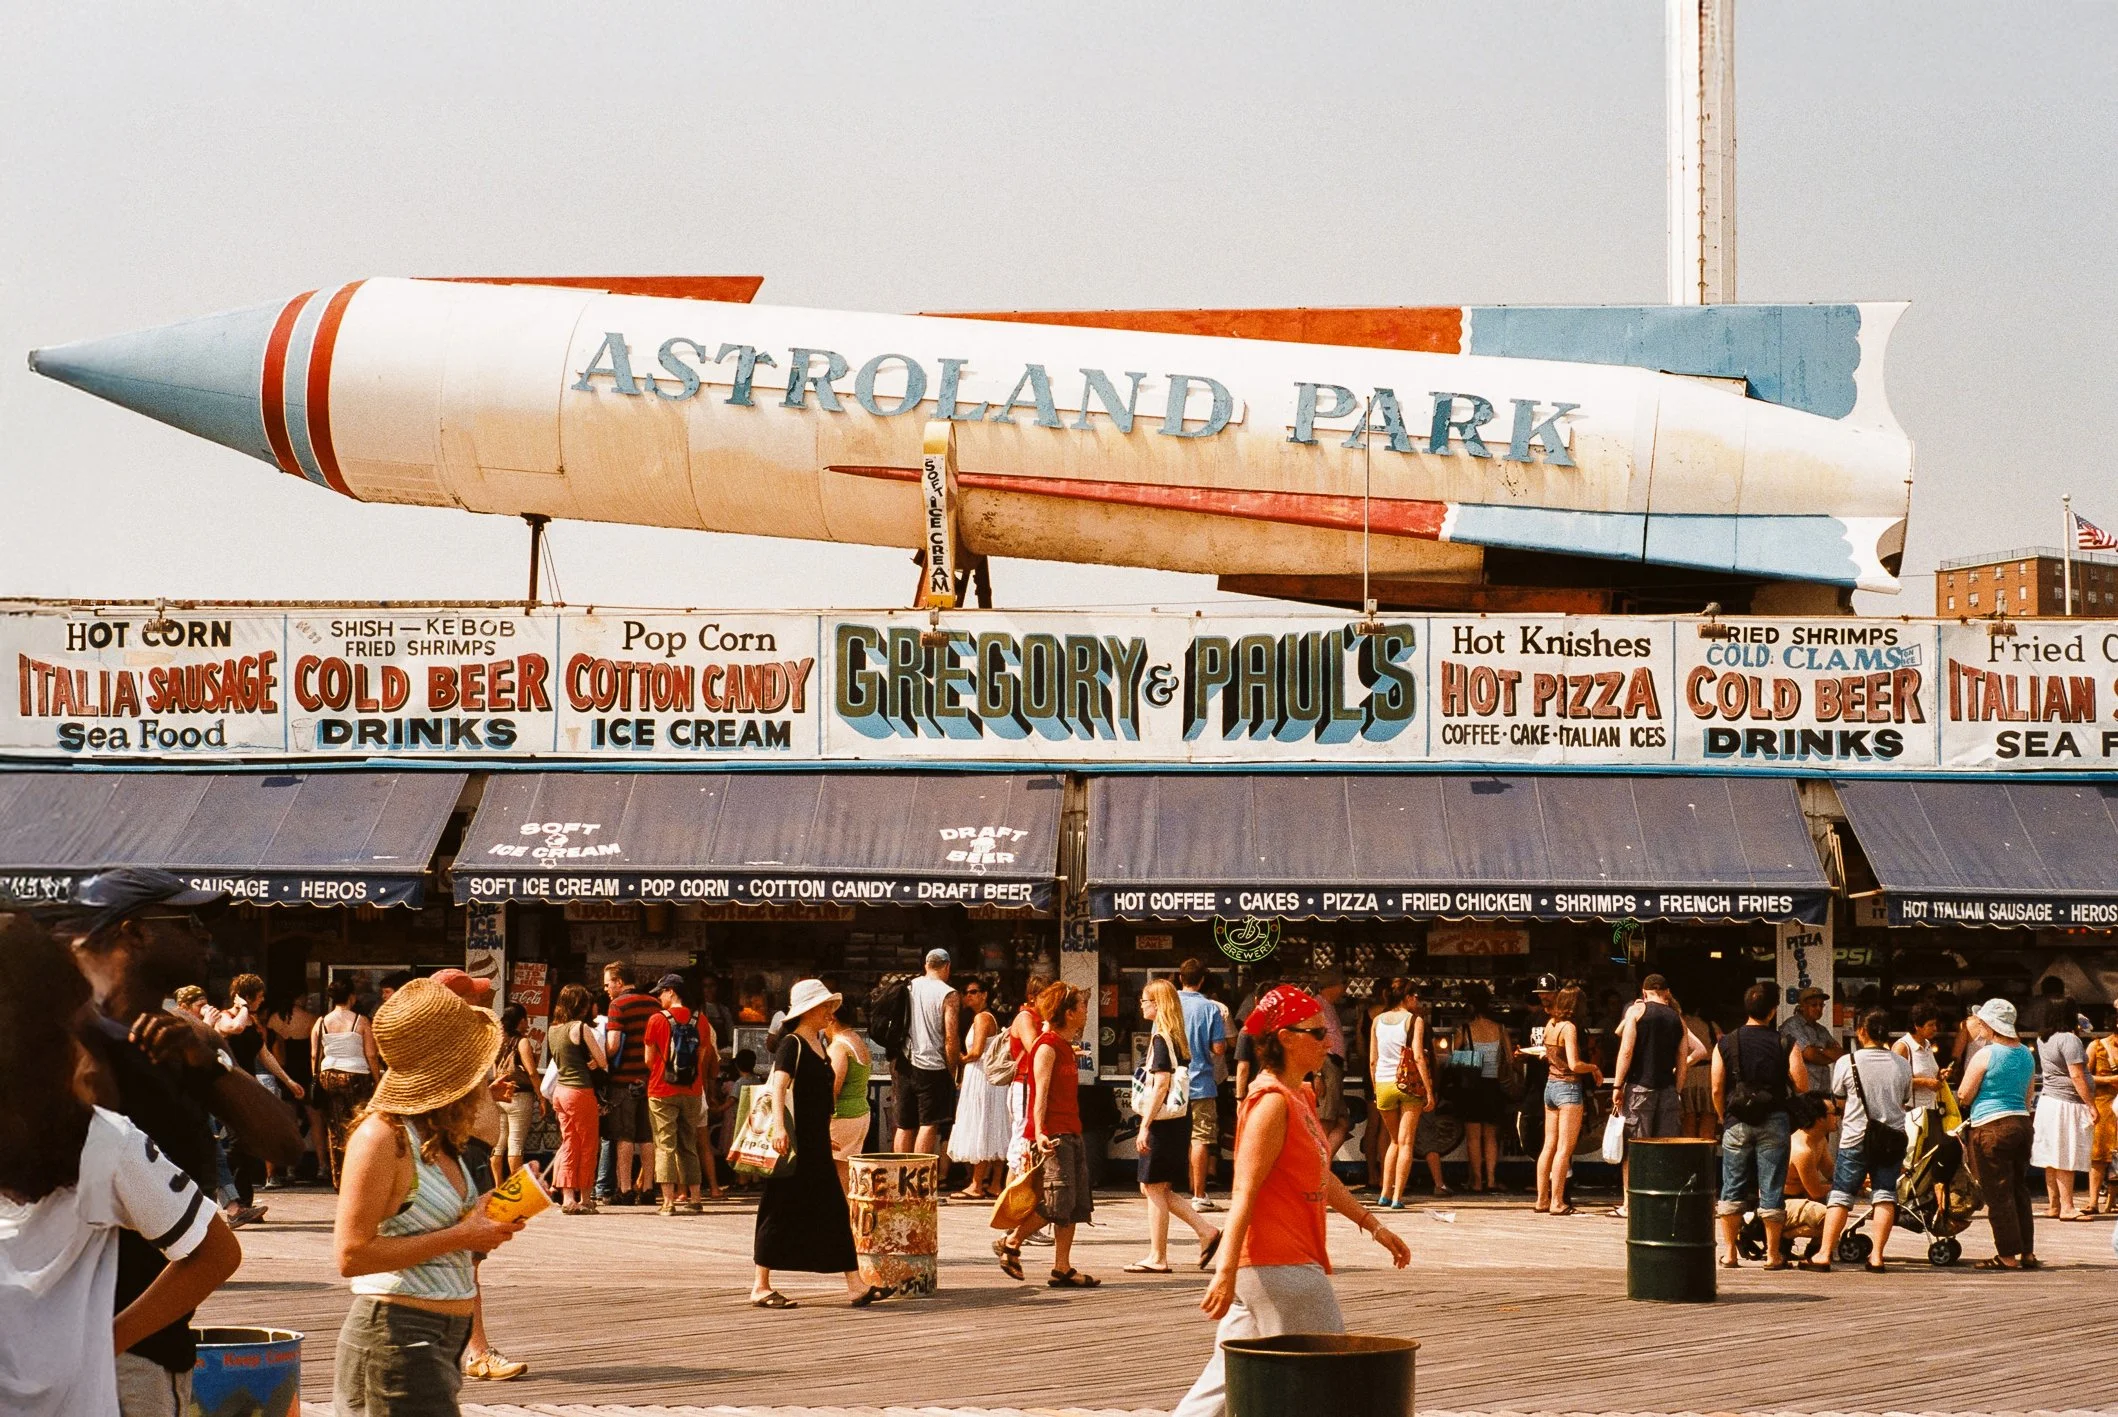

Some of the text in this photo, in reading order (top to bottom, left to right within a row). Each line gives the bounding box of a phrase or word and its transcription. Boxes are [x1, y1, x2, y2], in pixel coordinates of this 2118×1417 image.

[572, 331, 1581, 467] ASTROLAND PARK
[924, 460, 943, 498] SOFT
[929, 496, 943, 529] ICE
[929, 532, 951, 593] CREAM
[66, 620, 232, 651] HOT CORN
[330, 620, 394, 638] SHISH
[622, 620, 777, 658] Pop Corn
[1452, 625, 1652, 657] Hot Knishes
[1711, 626, 1899, 645] RIED SHRIMPS
[346, 640, 497, 657] FRIED SHRIMPS
[1706, 643, 1904, 671] COLD CLAMS
[1987, 633, 2086, 663] Fried
[146, 650, 279, 714] SAUSAGE
[294, 652, 554, 713] COLD BEER
[566, 652, 815, 714] COTTON CANDY
[834, 622, 1418, 744] GREGORY & PAUL'S
[1441, 660, 1662, 720] HOT PIZZA
[1686, 665, 1926, 724] COLD BEER
[1948, 657, 2096, 723] ITALIAN
[57, 719, 228, 752] Sea Food
[315, 717, 518, 751] DRINKS
[591, 717, 792, 751] ICE CREAM
[1442, 723, 1666, 748] COFFEE CAKE ITALIAN ICES
[1702, 727, 1905, 762] DRINKS
[1995, 730, 2082, 759] SEA
[520, 822, 602, 836] SOFT
[939, 826, 1029, 843] DRAFT
[488, 843, 622, 858] ICE CREAM
[945, 849, 1015, 864] BEER
[191, 878, 367, 900] SAUSAGE HEROS
[468, 877, 1033, 901] SOFT ICE CREAM POP CORN COTTON CANDY DRAFT BEER
[1114, 892, 1795, 913] HOT COFFEE CAKES PIZZA FRIED CHICKEN SHRIMPS FRENCH FRIES
[1902, 900, 2118, 923] HOT ITALIAN SAUSAGE HEROS
[1222, 940, 1272, 960] BREWERY
[1786, 931, 1824, 950] PIZZA
[1832, 947, 1873, 966] PSI
